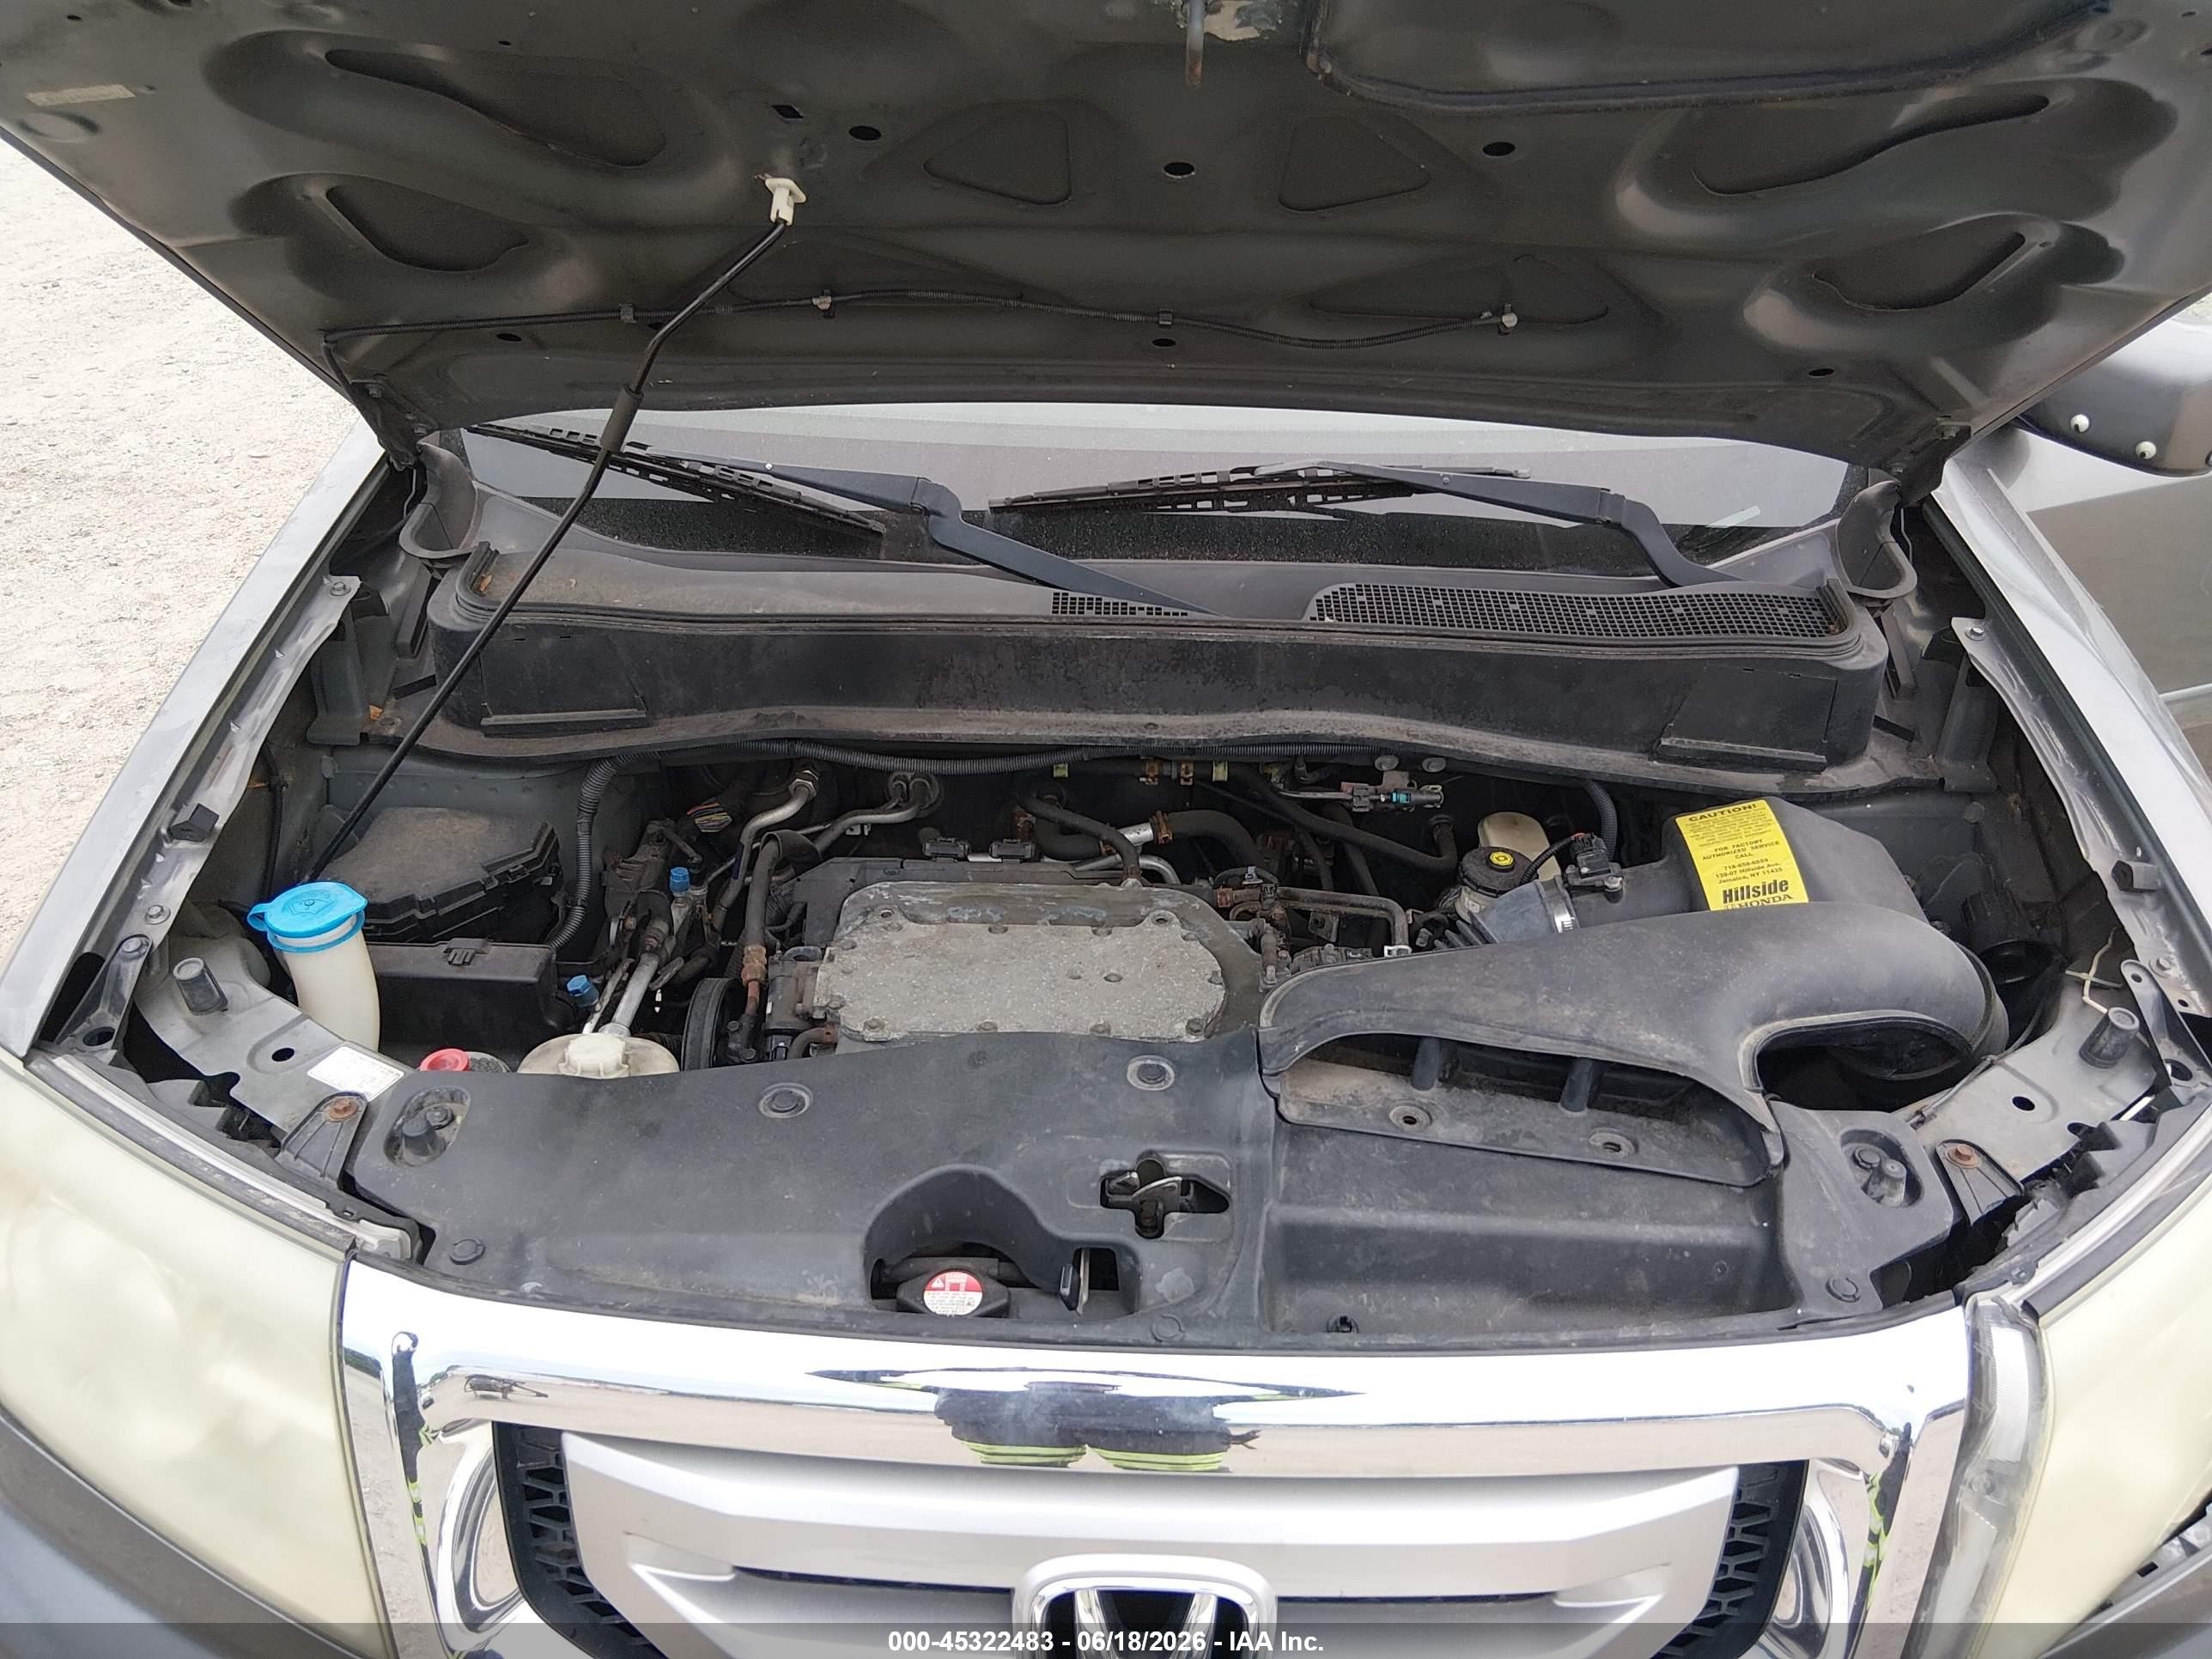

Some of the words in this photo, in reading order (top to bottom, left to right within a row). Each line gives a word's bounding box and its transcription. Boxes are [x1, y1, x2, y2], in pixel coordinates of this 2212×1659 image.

[1688, 804, 1757, 822] CAUTION!
[1703, 848, 1747, 860] AUTHORIZED
[1750, 841, 1780, 851] SERVICE
[1732, 839, 1763, 848] FACTORY
[1739, 864, 1765, 873] Hillside
[1723, 879, 1789, 904] Hillside
[1736, 894, 1793, 908] HONDA
